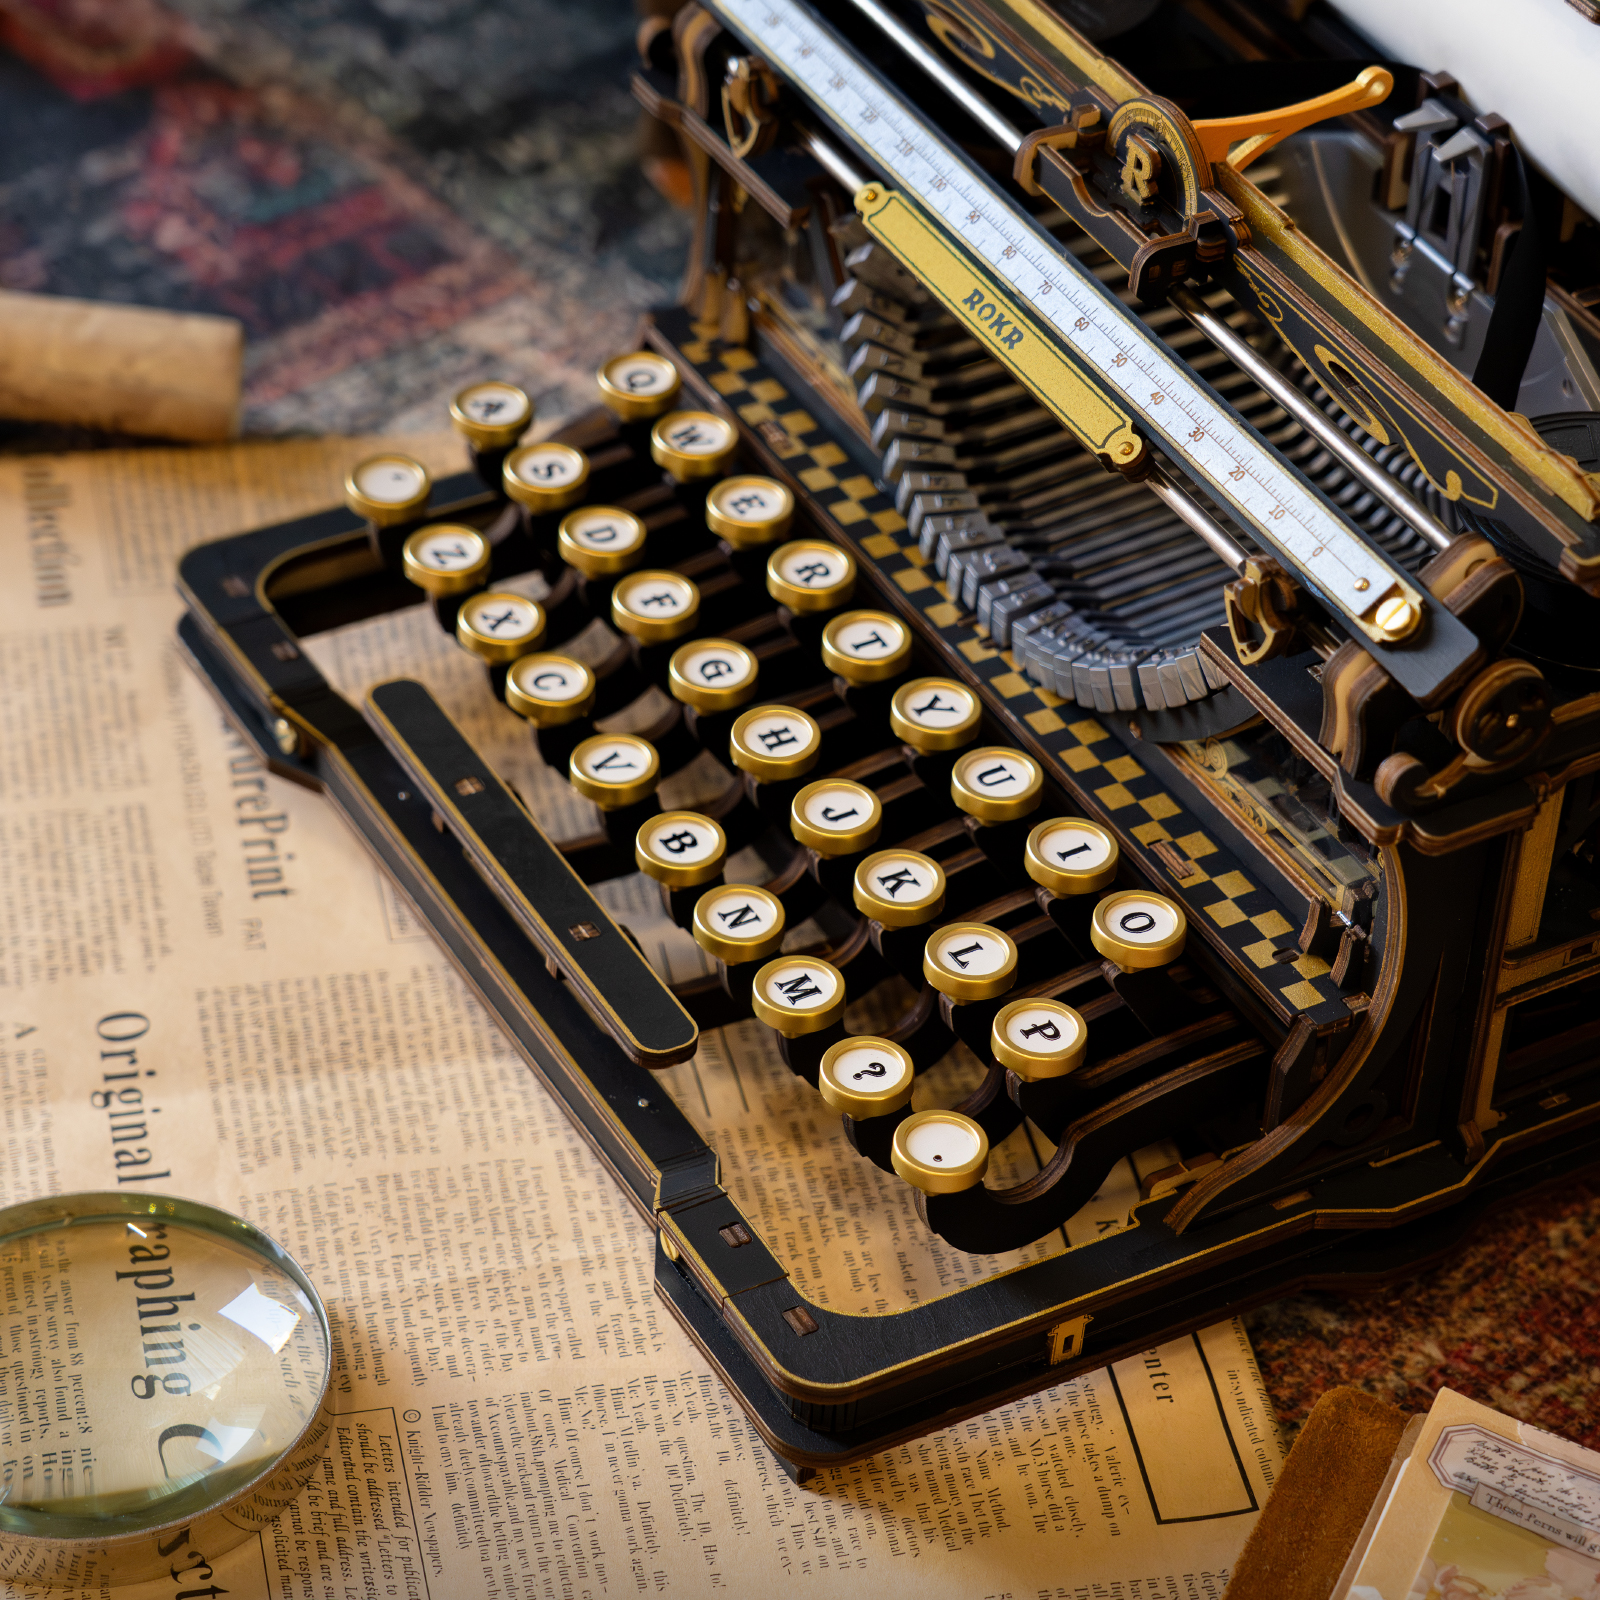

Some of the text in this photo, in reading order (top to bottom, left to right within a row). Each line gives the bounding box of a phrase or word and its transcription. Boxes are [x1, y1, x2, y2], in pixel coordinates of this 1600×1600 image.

[895, 136, 915, 157] 110
[1121, 134, 1160, 206] R
[928, 174, 948, 193] 100
[965, 210, 981, 225] 90
[1001, 244, 1018, 261] 80
[1037, 278, 1053, 295] 70
[961, 288, 1025, 351] ROKR
[1073, 316, 1091, 334] 60
[1111, 352, 1129, 369] 50
[625, 371, 657, 392] Q
[477, 401, 505, 417] A
[1148, 389, 1167, 408] 40
[669, 426, 712, 447] W
[1187, 426, 1205, 444] 30
[532, 463, 565, 479] S
[1227, 464, 1246, 483] 20
[730, 495, 765, 515] E
[1268, 504, 1287, 522] 10
[584, 526, 618, 543] D
[432, 545, 468, 565] Z
[1311, 544, 1324, 558] 0
[795, 563, 831, 583] R
[641, 593, 677, 607] F
[482, 610, 519, 631] X
[852, 631, 887, 650] T
[700, 660, 733, 681] G
[533, 673, 567, 690] C
[907, 695, 956, 722] Y
[758, 727, 798, 751] H
[592, 752, 635, 772] V
[977, 765, 1016, 786] U
[821, 807, 858, 822] J
[659, 831, 698, 854] B
[1057, 842, 1092, 861] I
[873, 868, 920, 898] K
[718, 904, 761, 929] N
[1120, 912, 1156, 934] O
[945, 942, 983, 970] L
[769, 973, 822, 1005] M
[1020, 1020, 1061, 1041] P
[853, 1062, 887, 1080] ?
[90, 1010, 172, 1185] Original
[22, 1270, 38, 1309] interest
[27, 1314, 42, 1326] in
[66, 1322, 79, 1349] from
[326, 1298, 348, 1373] handicapping
[610, 1313, 632, 1358] frenzied
[70, 1352, 84, 1366] 88
[9, 1324, 35, 1443] those questioned in
[627, 1378, 640, 1399] Me:
[643, 1375, 658, 1396] Has
[649, 1399, 660, 1410] to
[1066, 1391, 1081, 1407] the
[33, 1389, 51, 1439] reports.
[433, 1412, 449, 1431] had
[1072, 1410, 1090, 1439] horse
[356, 1423, 376, 1459] should
[437, 1434, 448, 1444] to
[659, 1440, 673, 1456] the
[1008, 1437, 1026, 1457] and
[378, 1435, 395, 1473] Letters
[439, 1446, 453, 1468] envy
[1083, 1443, 1100, 1472] takes
[319, 1456, 336, 1485] name
[363, 1462, 379, 1474] be
[608, 1456, 623, 1485] never
[1016, 1463, 1030, 1476] he
[1104, 1446, 1126, 1487] Valerie
[662, 1379, 678, 1407] Him:
[672, 1411, 683, 1426] No
[690, 1494, 705, 1513] The
[703, 1544, 717, 1565] Has
[710, 1573, 726, 1588] to!
[966, 1423, 1011, 1533] the Name Method.
[308, 1495, 323, 1507] be
[327, 1490, 346, 1510] and
[347, 1484, 367, 1526] contain
[366, 1478, 391, 1531] addressed
[387, 1481, 410, 1528] intended
[614, 1489, 632, 1522] gonna
[724, 1479, 750, 1536] definitely!
[1097, 1486, 1115, 1518] dump
[286, 1498, 305, 1535] cannot
[326, 1507, 350, 1533] full
[669, 1483, 696, 1542] Definitely!
[1033, 1511, 1048, 1534] The
[1486, 1493, 1524, 1519] These
[1566, 1533, 1587, 1547] will
[308, 1511, 330, 1537] brief
[451, 1503, 473, 1549] definitely
[1109, 1522, 1121, 1536] on
[295, 1540, 311, 1552] be
[355, 1530, 372, 1547] the
[391, 1534, 414, 1552] for
[625, 1526, 643, 1555] work
[316, 1540, 333, 1560] and
[336, 1537, 354, 1581] address.
[320, 1564, 332, 1581] are
[631, 1558, 650, 1593] again.
[386, 1584, 398, 1595] to
